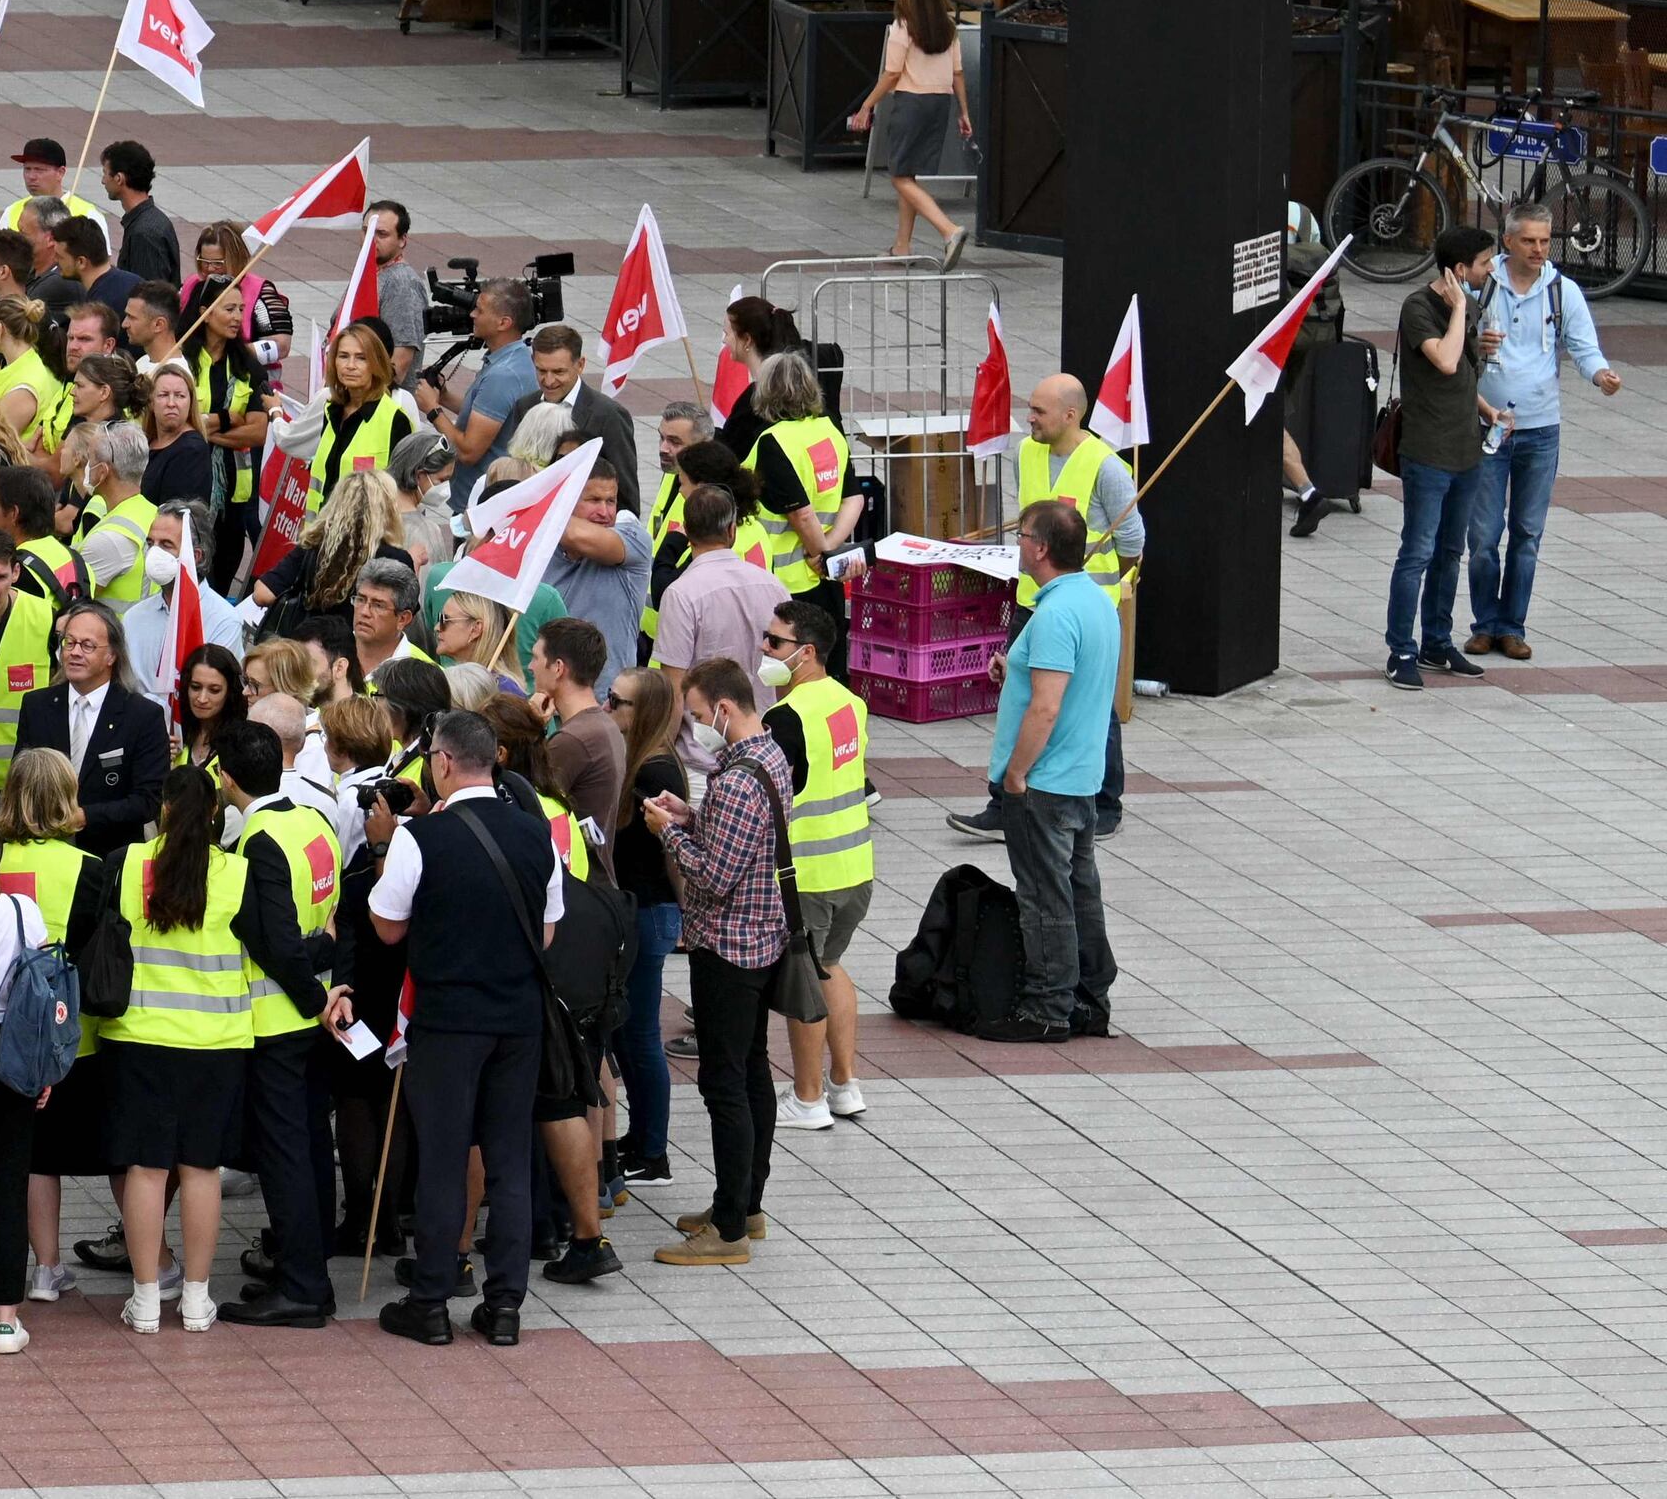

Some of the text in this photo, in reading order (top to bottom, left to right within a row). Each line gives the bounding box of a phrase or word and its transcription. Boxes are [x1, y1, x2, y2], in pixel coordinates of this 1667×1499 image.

[10, 679, 33, 688] ver.di
[833, 737, 858, 758] ver.di
[312, 869, 334, 892] ver.di
